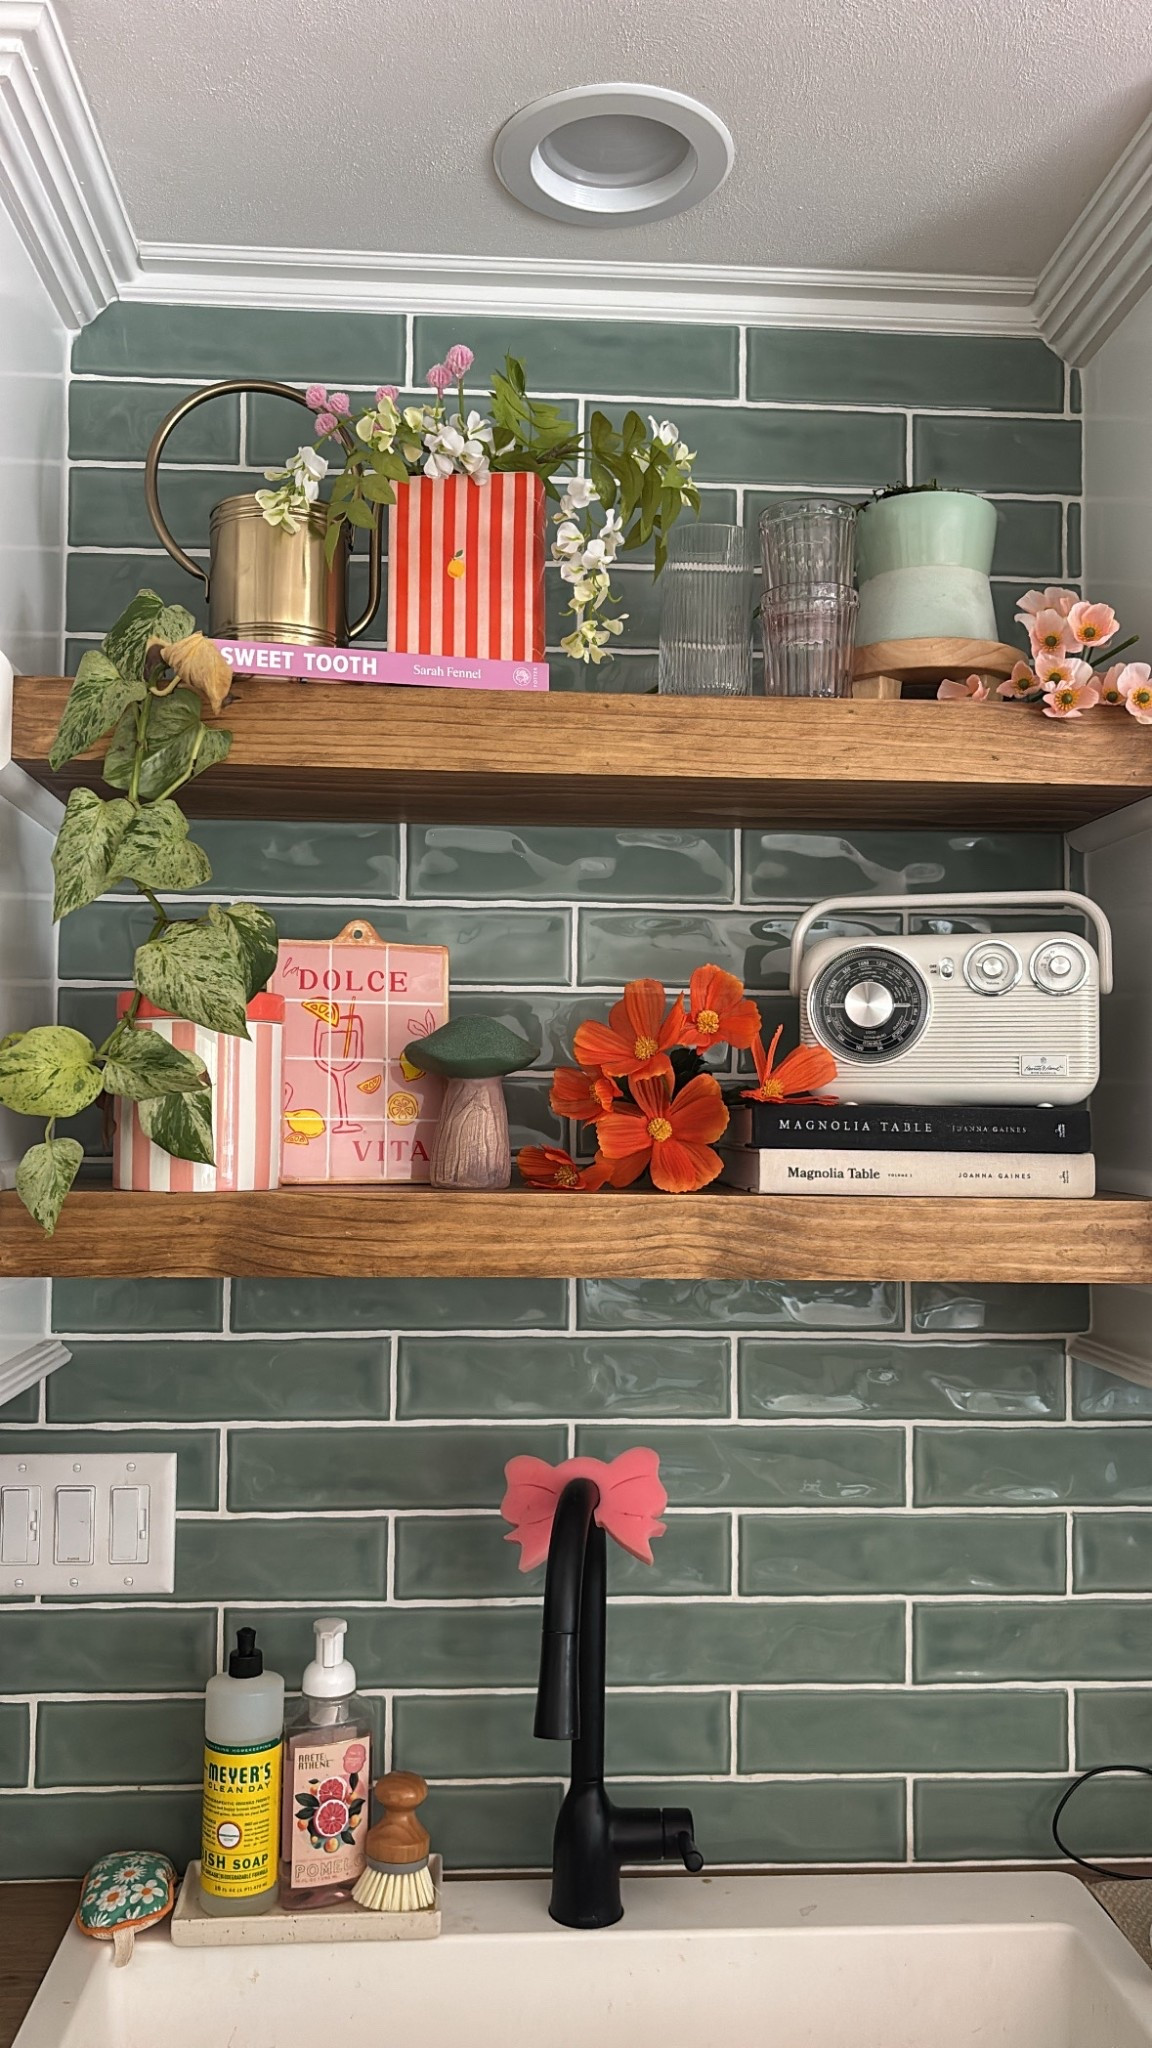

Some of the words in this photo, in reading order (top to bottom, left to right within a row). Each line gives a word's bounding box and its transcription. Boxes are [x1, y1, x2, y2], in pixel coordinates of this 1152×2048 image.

[220, 647, 294, 669] SWEET
[303, 652, 377, 675] TOOTH
[413, 664, 444, 677] Sarah
[447, 667, 481, 679] Fennel
[282, 957, 300, 978] la
[298, 968, 408, 993] DOLCE
[779, 1119, 871, 1132] MAGNOLIA
[880, 1122, 933, 1133] TABLE
[992, 1126, 1027, 1134] GAINES
[353, 1140, 431, 1162] VITA
[787, 1166, 844, 1181] Magnolia
[847, 1167, 881, 1179] Table
[958, 1171, 993, 1179] JOANNA
[998, 1172, 1032, 1180] GAINES
[208, 1762, 271, 1784] MEYER'S
[208, 1781, 243, 1794] CLEAN
[248, 1781, 271, 1793] DAY
[232, 1853, 269, 1870] SOAP
